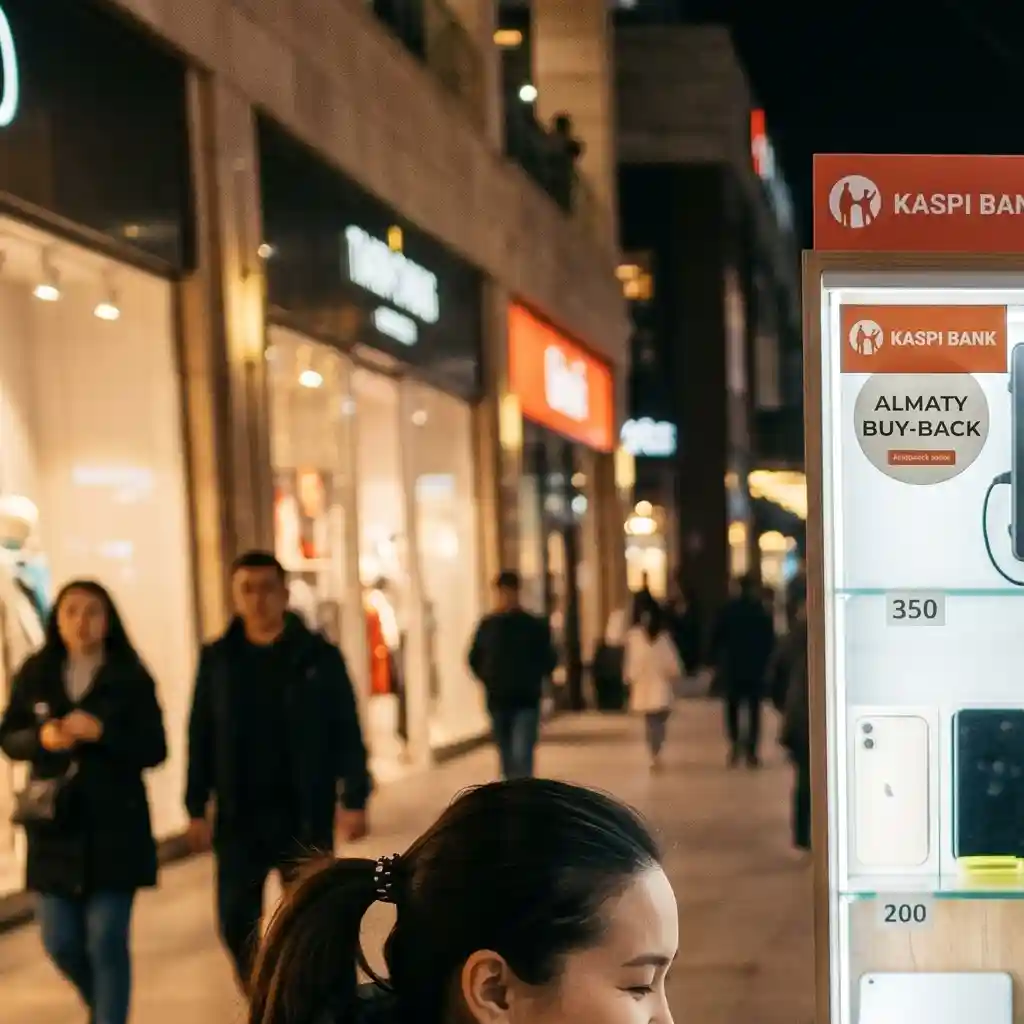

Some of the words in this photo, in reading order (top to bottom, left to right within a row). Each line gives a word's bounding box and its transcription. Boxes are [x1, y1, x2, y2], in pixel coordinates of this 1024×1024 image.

[893, 193, 972, 215] KASPI
[890, 331, 943, 346] KASPI
[947, 331, 997, 347] BANK
[874, 395, 968, 412] ALMATY
[862, 420, 981, 438] BUY-BACK
[892, 599, 938, 619] 350
[884, 904, 927, 923] 200
